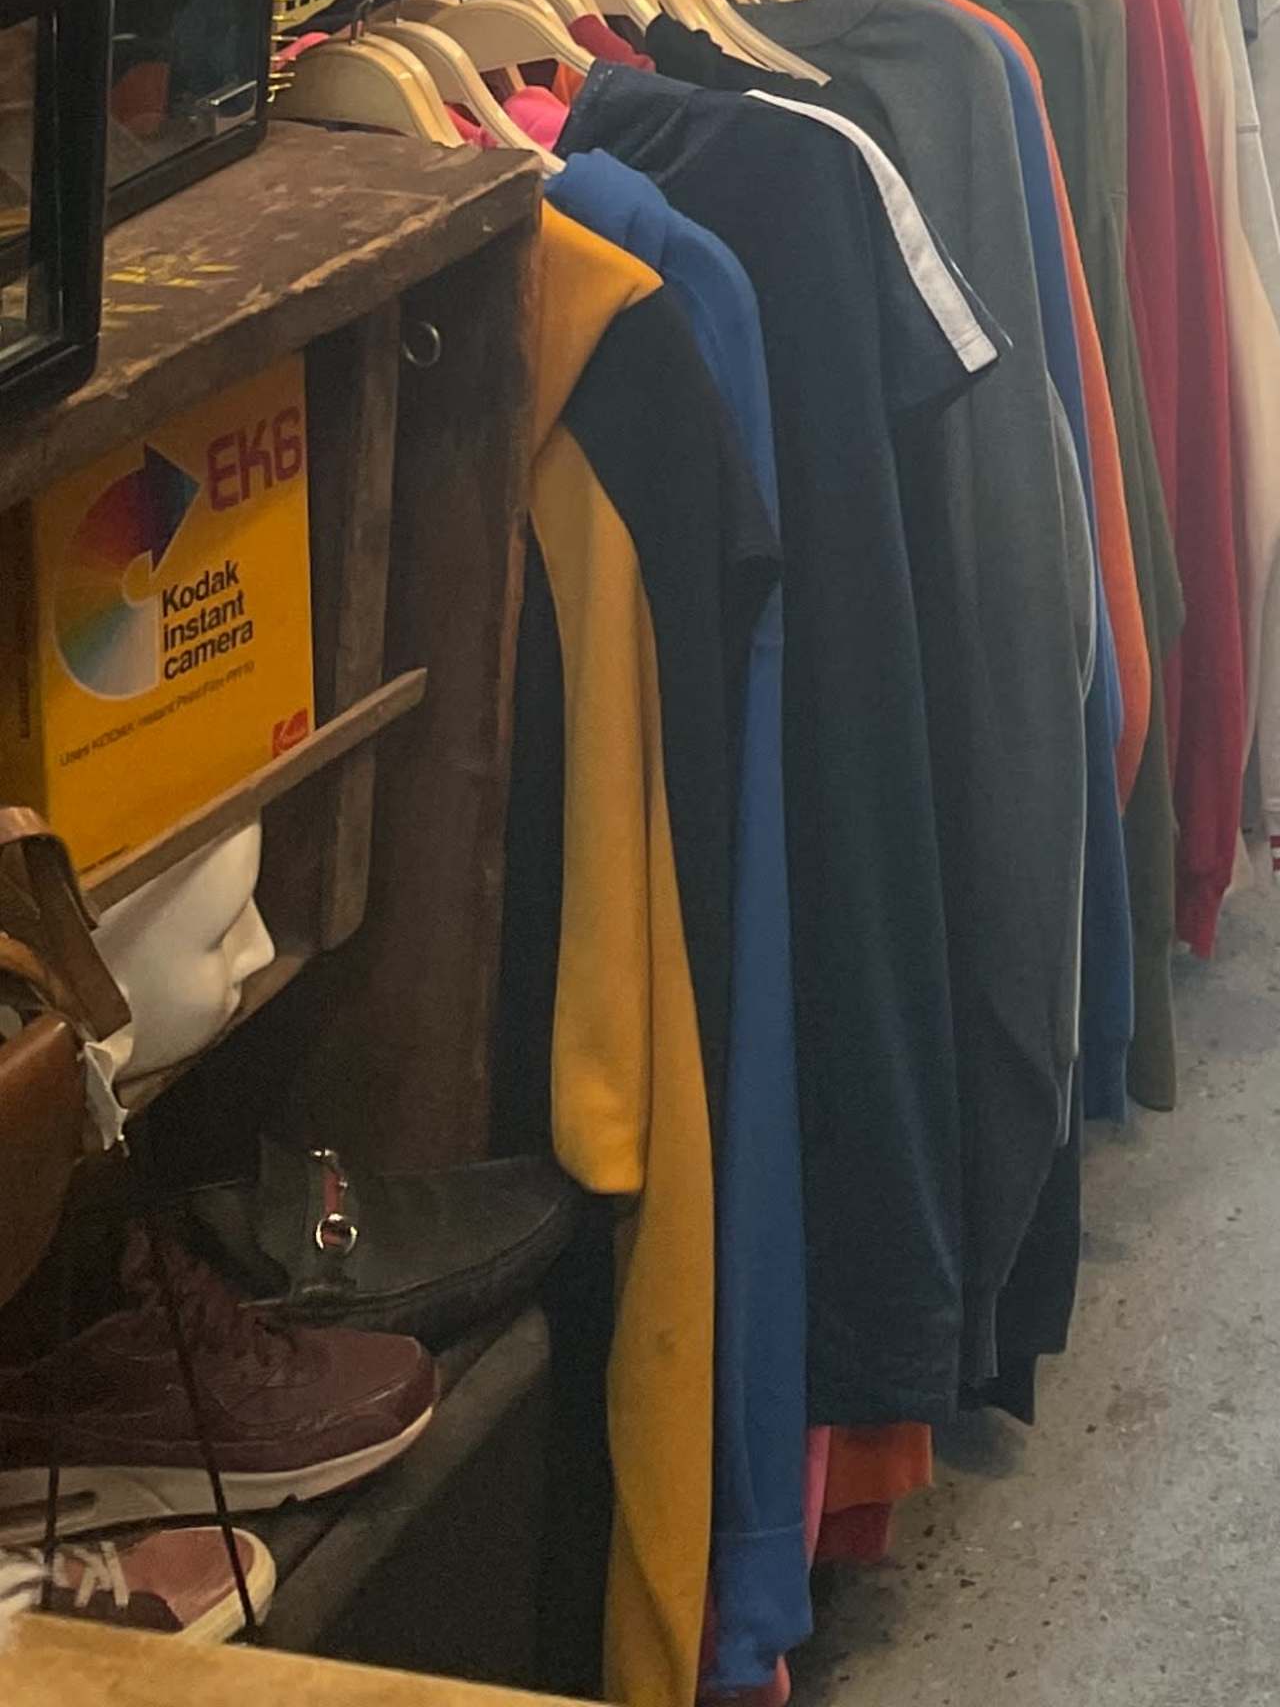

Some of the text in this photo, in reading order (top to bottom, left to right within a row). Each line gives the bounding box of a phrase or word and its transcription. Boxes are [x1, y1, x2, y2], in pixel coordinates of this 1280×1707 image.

[162, 560, 240, 618] Kodak
[163, 591, 245, 653] instant
[163, 619, 254, 680] camera
